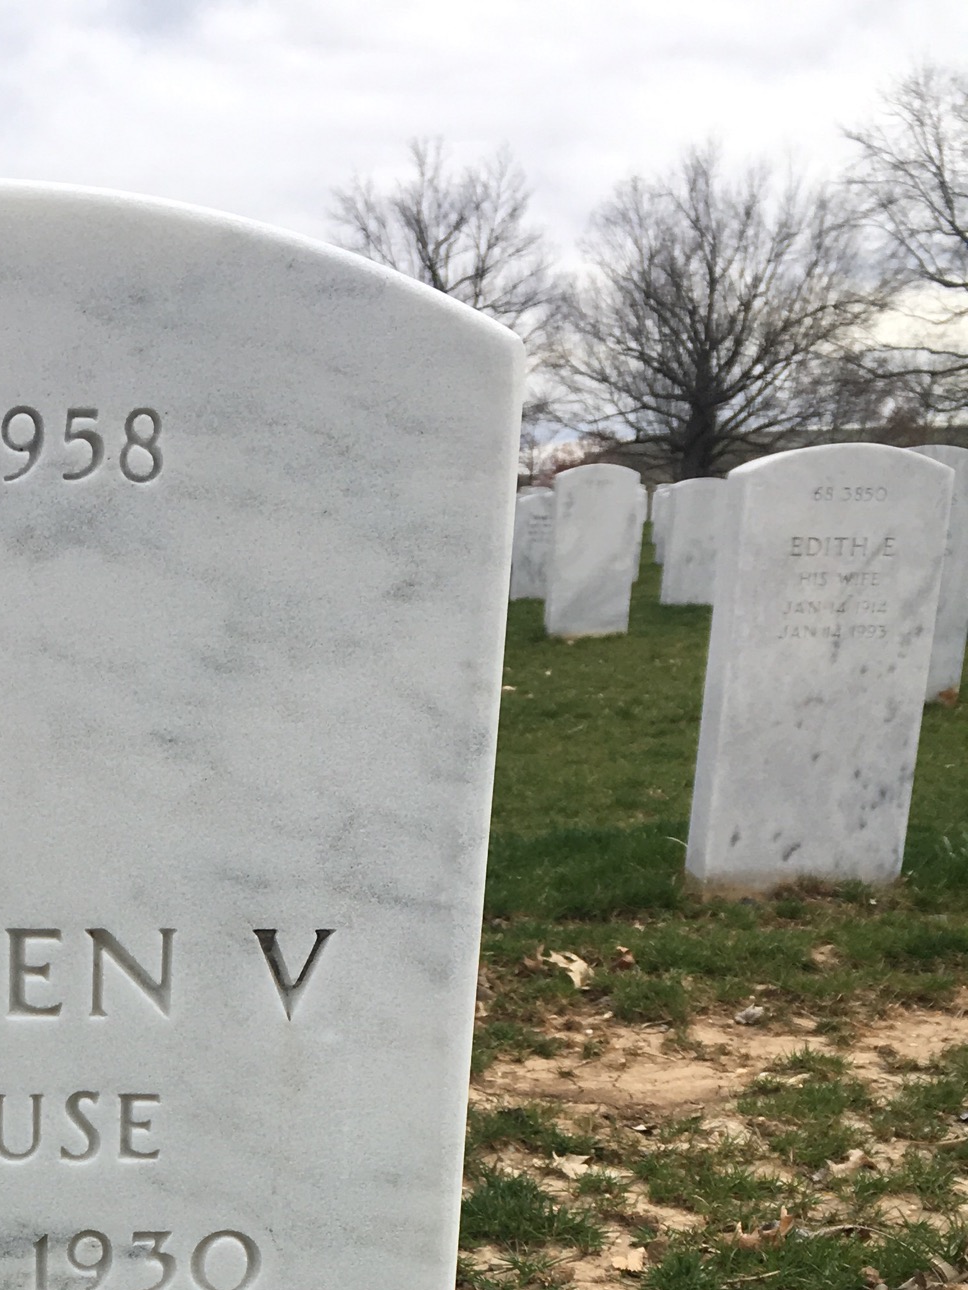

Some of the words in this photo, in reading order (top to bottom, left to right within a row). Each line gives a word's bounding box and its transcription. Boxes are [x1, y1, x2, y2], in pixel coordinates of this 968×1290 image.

[813, 486, 834, 501] 68
[842, 486, 888, 502] 3850
[790, 536, 869, 557] EDITH
[882, 536, 896, 557] E
[798, 571, 829, 587] HIS
[839, 571, 881, 587] WIFE
[783, 600, 822, 615] JAN
[776, 624, 817, 640] JAN
[253, 927, 338, 1022] V
